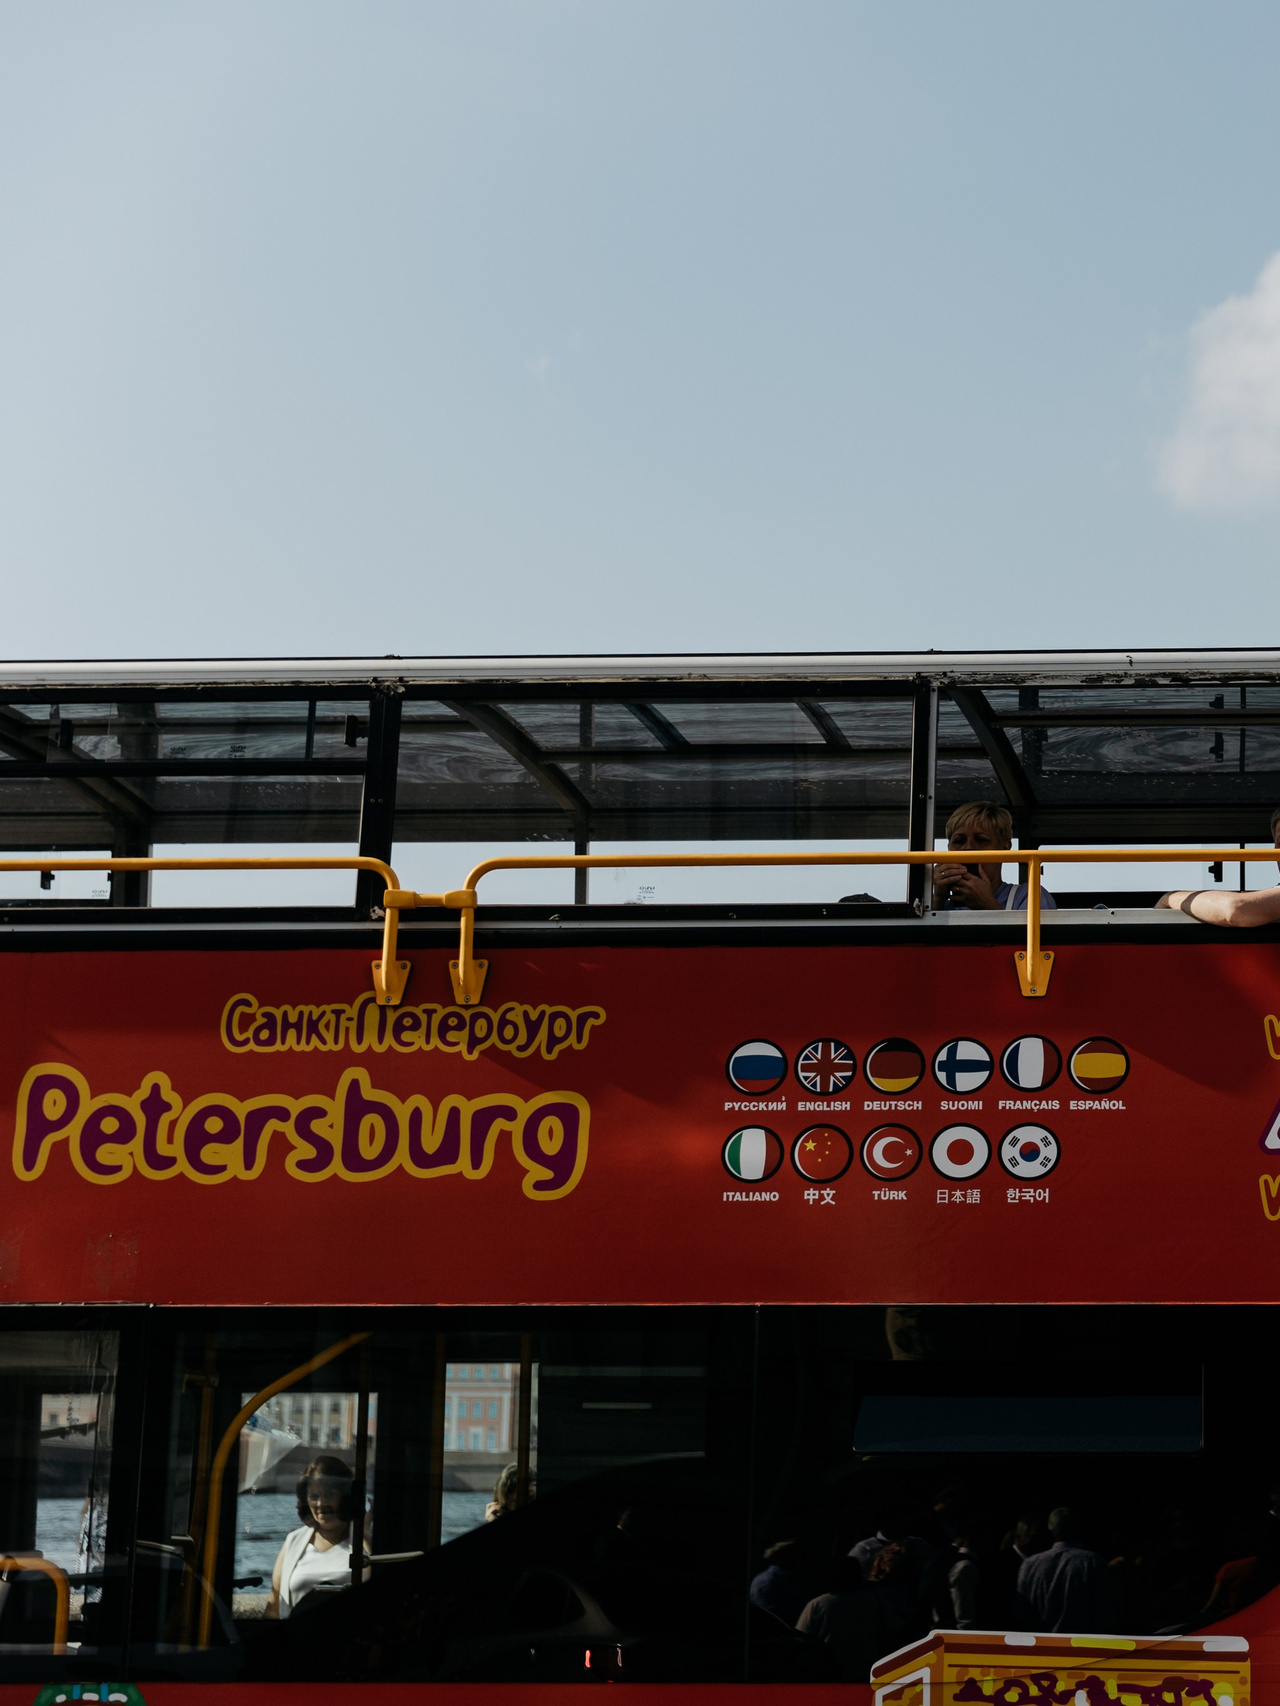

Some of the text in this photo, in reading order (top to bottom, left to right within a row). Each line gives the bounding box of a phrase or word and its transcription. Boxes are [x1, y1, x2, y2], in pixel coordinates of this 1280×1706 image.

[724, 1096, 786, 1111] РУССКИЙ
[797, 1101, 851, 1111] ENGLISH
[863, 1101, 922, 1111] DEUTSCH
[940, 1101, 983, 1111] SUOMI
[998, 1100, 1060, 1113] FRANÇAIS
[1069, 1097, 1126, 1111] ESPAÑOL
[12, 1062, 591, 1200] Petersburg
[723, 1191, 779, 1202] ITALIANO
[803, 1188, 836, 1205] 中文
[872, 1188, 907, 1201] TÜRK
[936, 1189, 981, 1204] 日本語
[1006, 1188, 1050, 1203] 한국어
